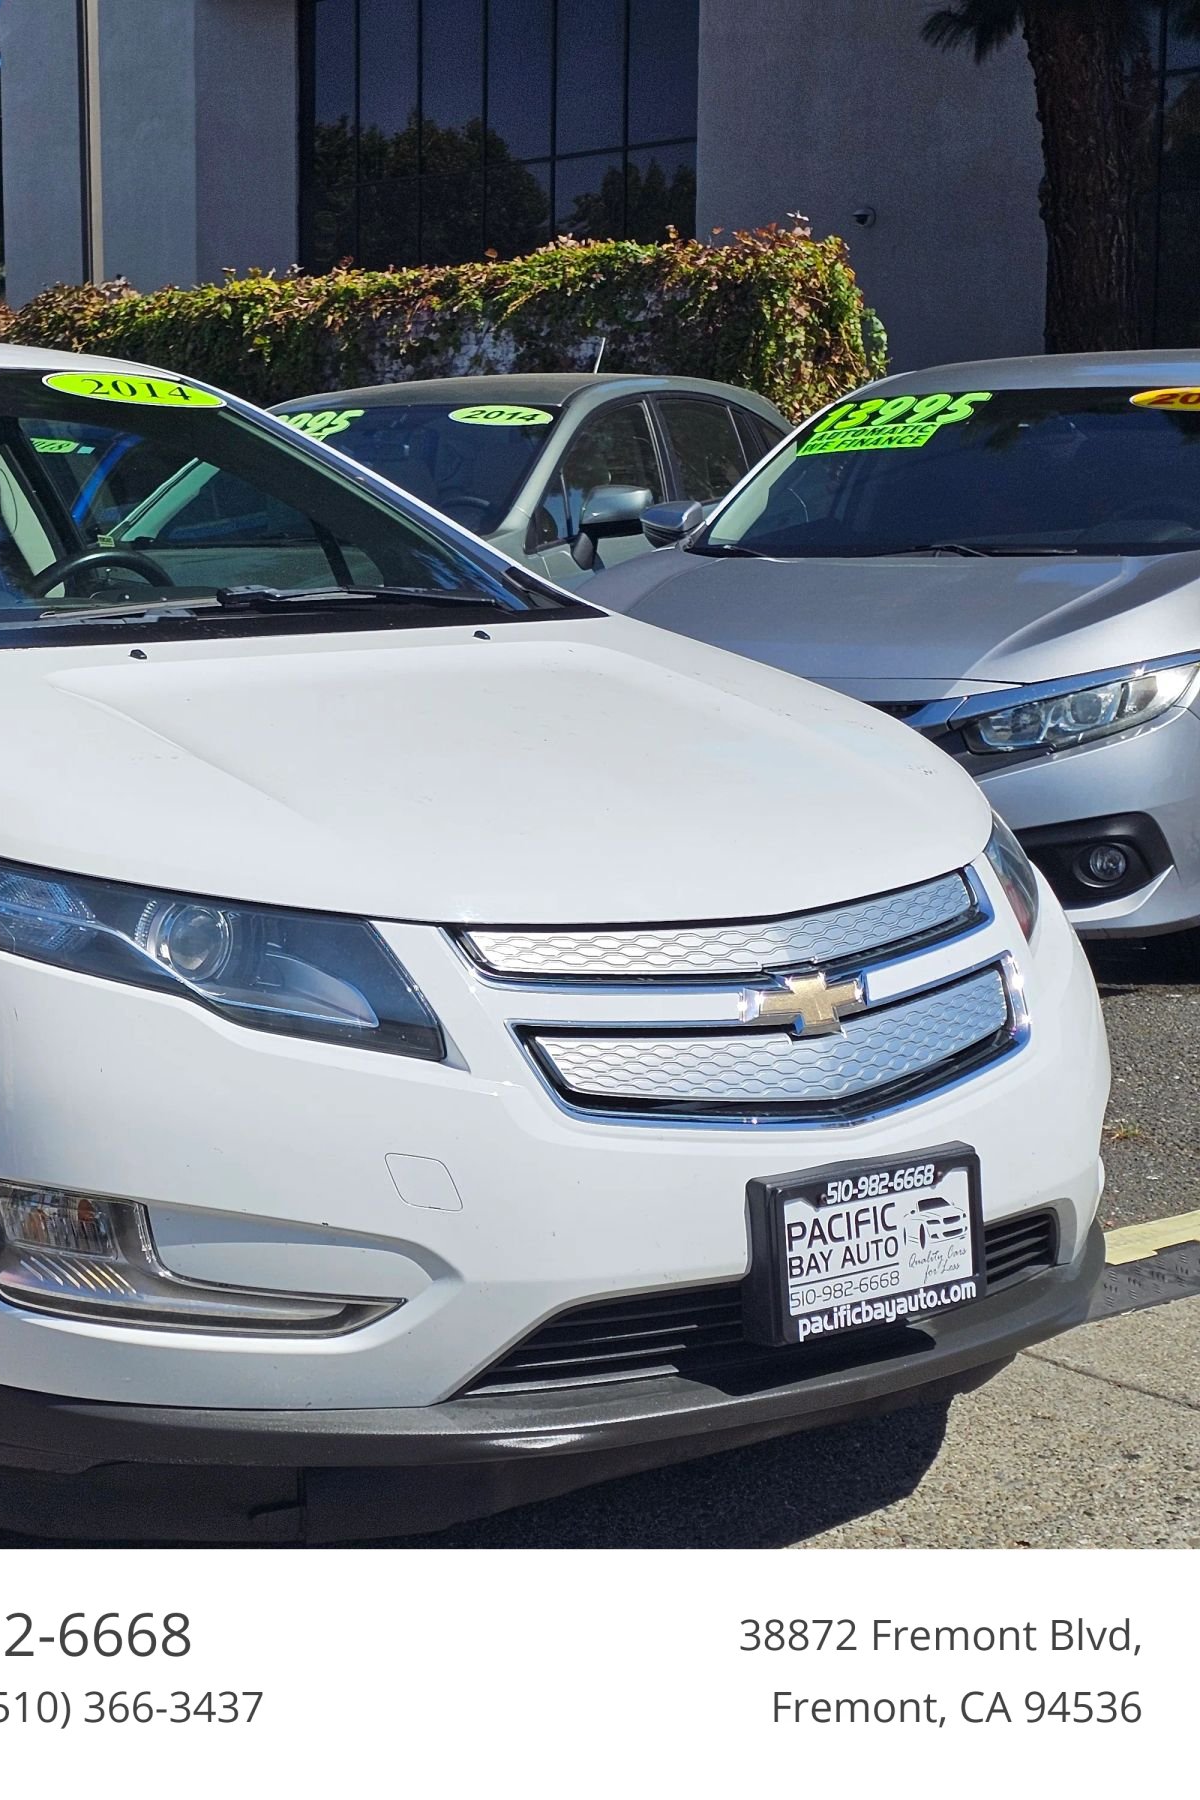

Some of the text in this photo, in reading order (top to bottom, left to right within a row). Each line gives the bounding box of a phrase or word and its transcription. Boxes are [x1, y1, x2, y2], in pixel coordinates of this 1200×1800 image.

[80, 378, 192, 401] 2014
[463, 409, 541, 423] 2014
[814, 392, 993, 432] 13995
[802, 435, 928, 454] WE FINANCE
[815, 424, 933, 442] AUTOMATIC
[826, 1164, 935, 1204] 510-982-6668
[786, 1202, 898, 1252] PACIFIC
[788, 1236, 899, 1279] BAY AUTO
[909, 1250, 943, 1269] Quality
[791, 1270, 900, 1309] 510-982-6668
[923, 1265, 937, 1284] for
[798, 1281, 977, 1342] pacificbayauto.com
